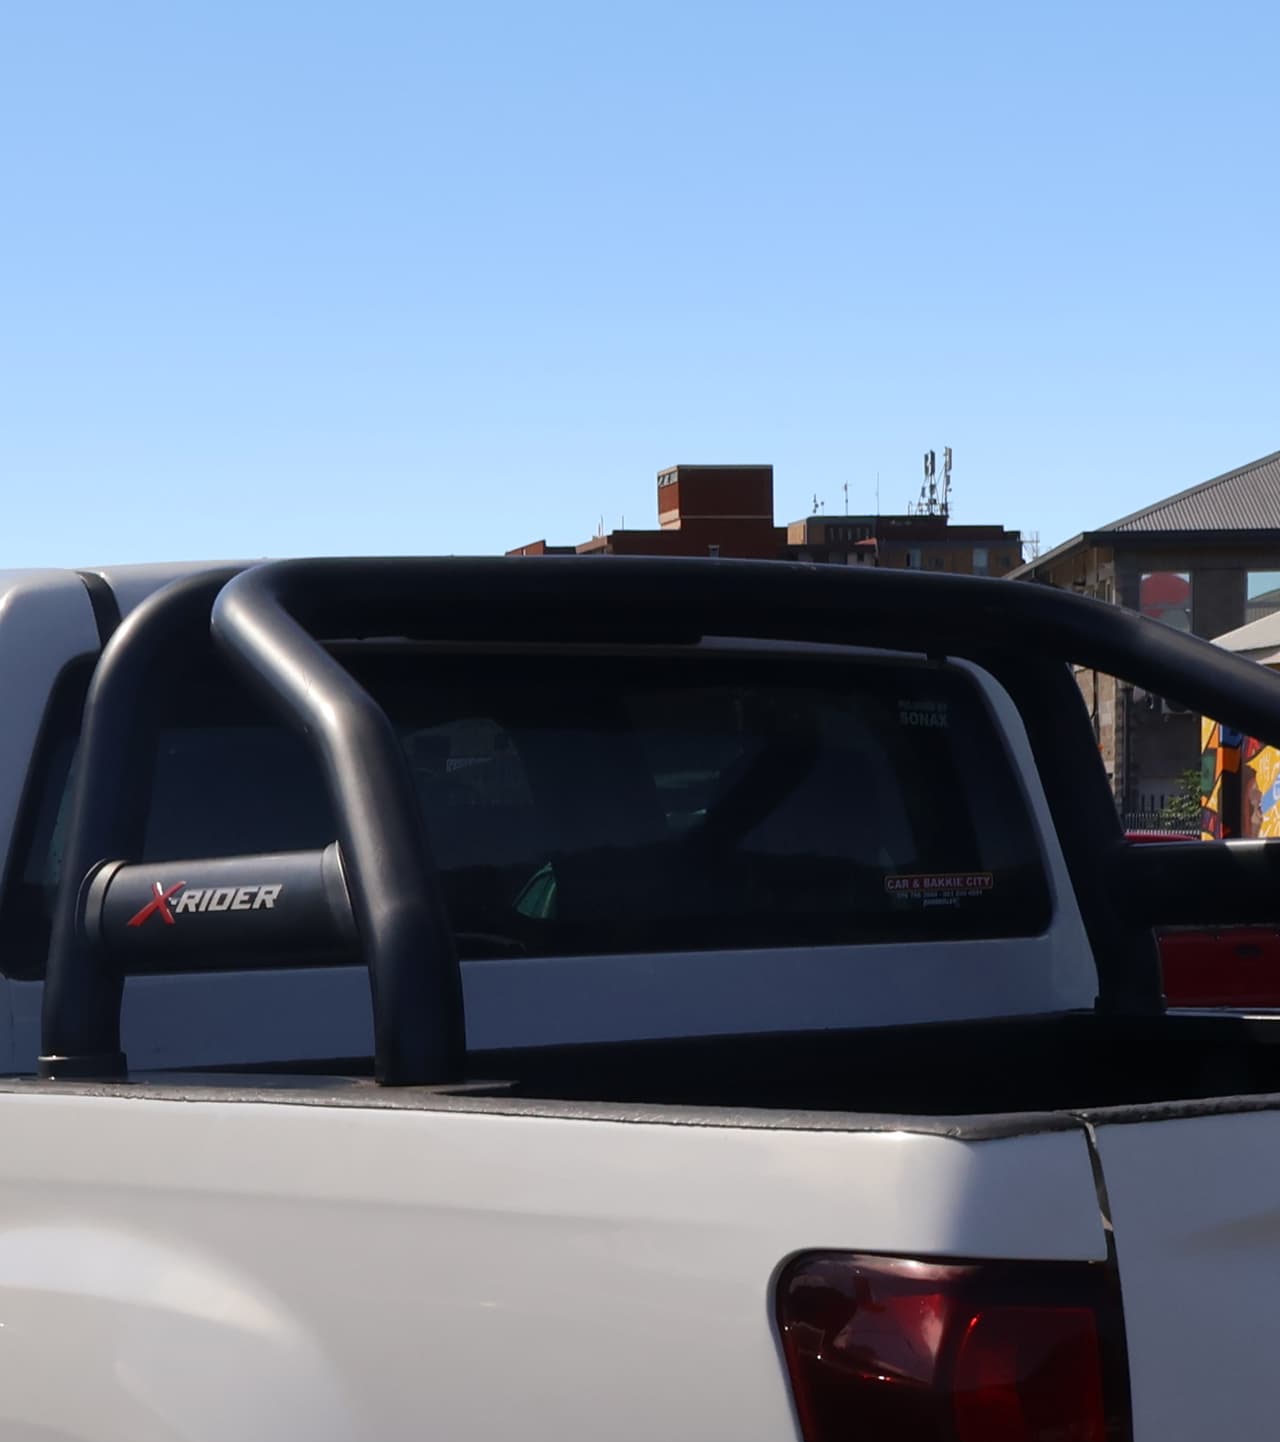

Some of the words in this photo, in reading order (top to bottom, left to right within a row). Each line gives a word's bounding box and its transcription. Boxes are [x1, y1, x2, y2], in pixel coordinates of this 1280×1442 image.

[887, 878, 910, 890] CAR
[966, 876, 991, 888] CITY
[127, 880, 284, 927] X-RIDER
